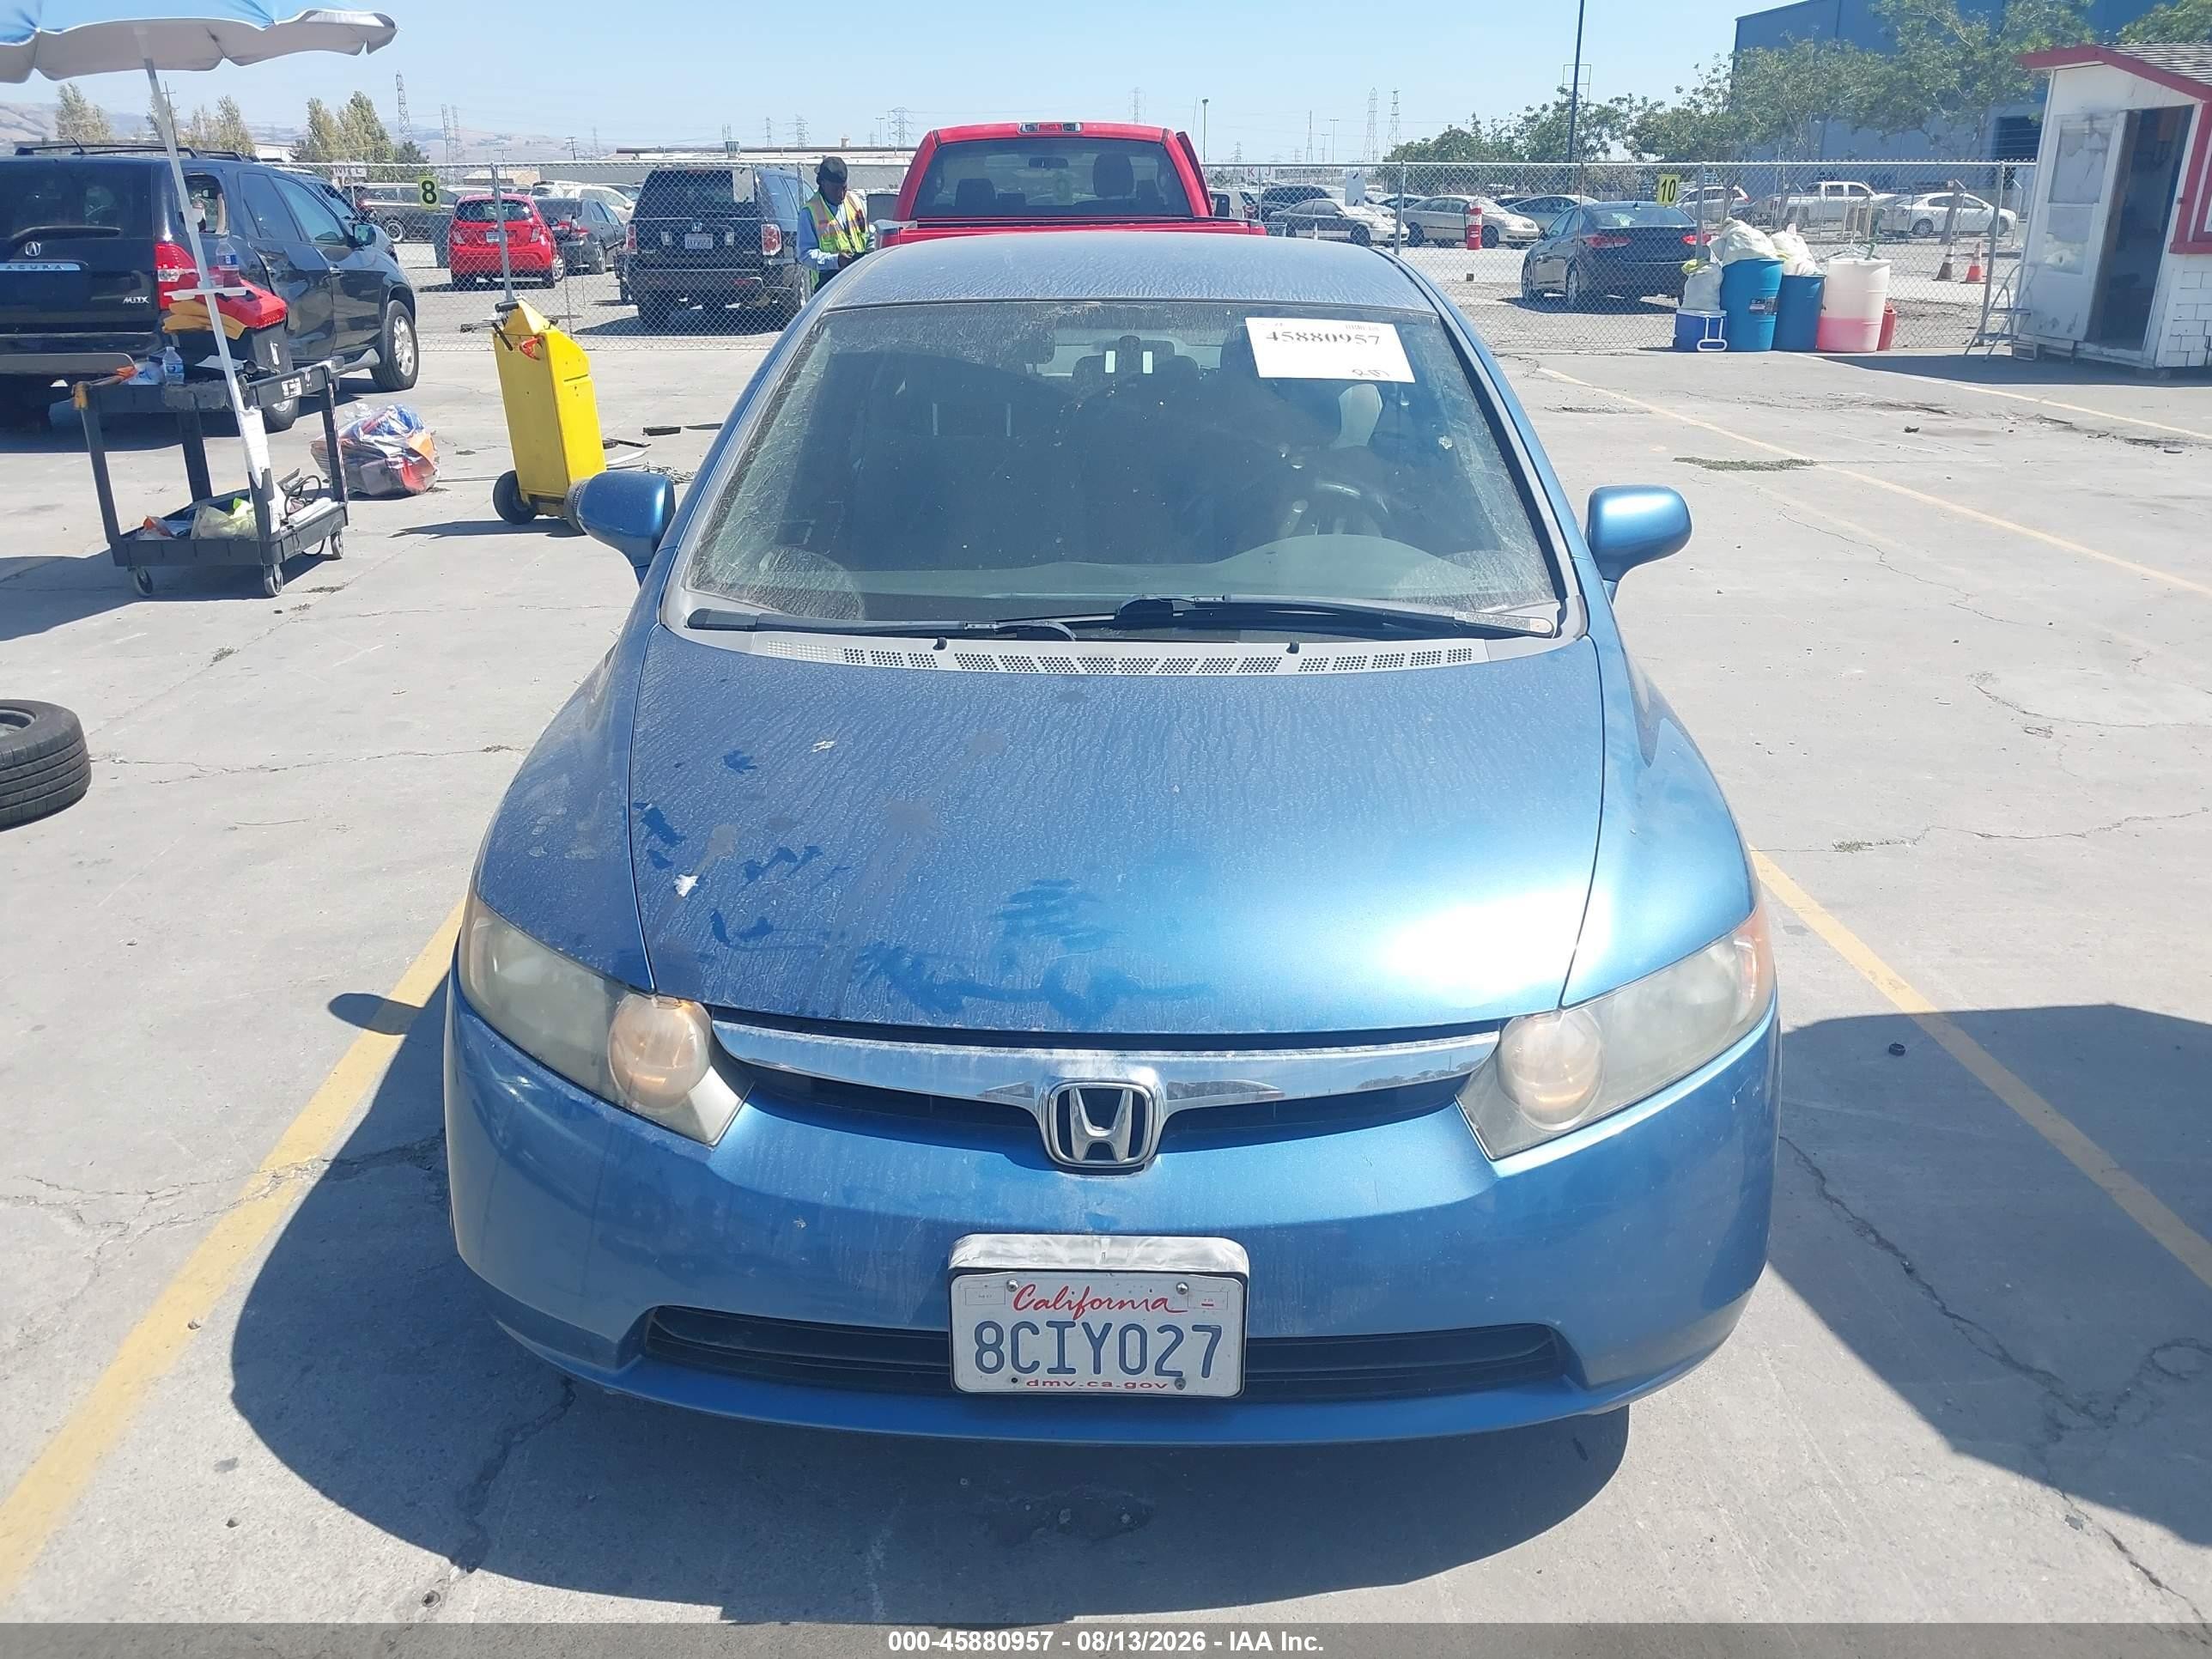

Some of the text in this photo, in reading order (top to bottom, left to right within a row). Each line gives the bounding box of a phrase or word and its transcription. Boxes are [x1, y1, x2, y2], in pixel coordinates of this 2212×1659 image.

[421, 179, 437, 204] 8
[1661, 179, 1677, 203] 10
[1266, 331, 1381, 346] 45880957
[1013, 1284, 1188, 1320] California
[974, 1320, 1223, 1379] 8CIY027
[1025, 1378, 1169, 1389] dmv.ca.gov
